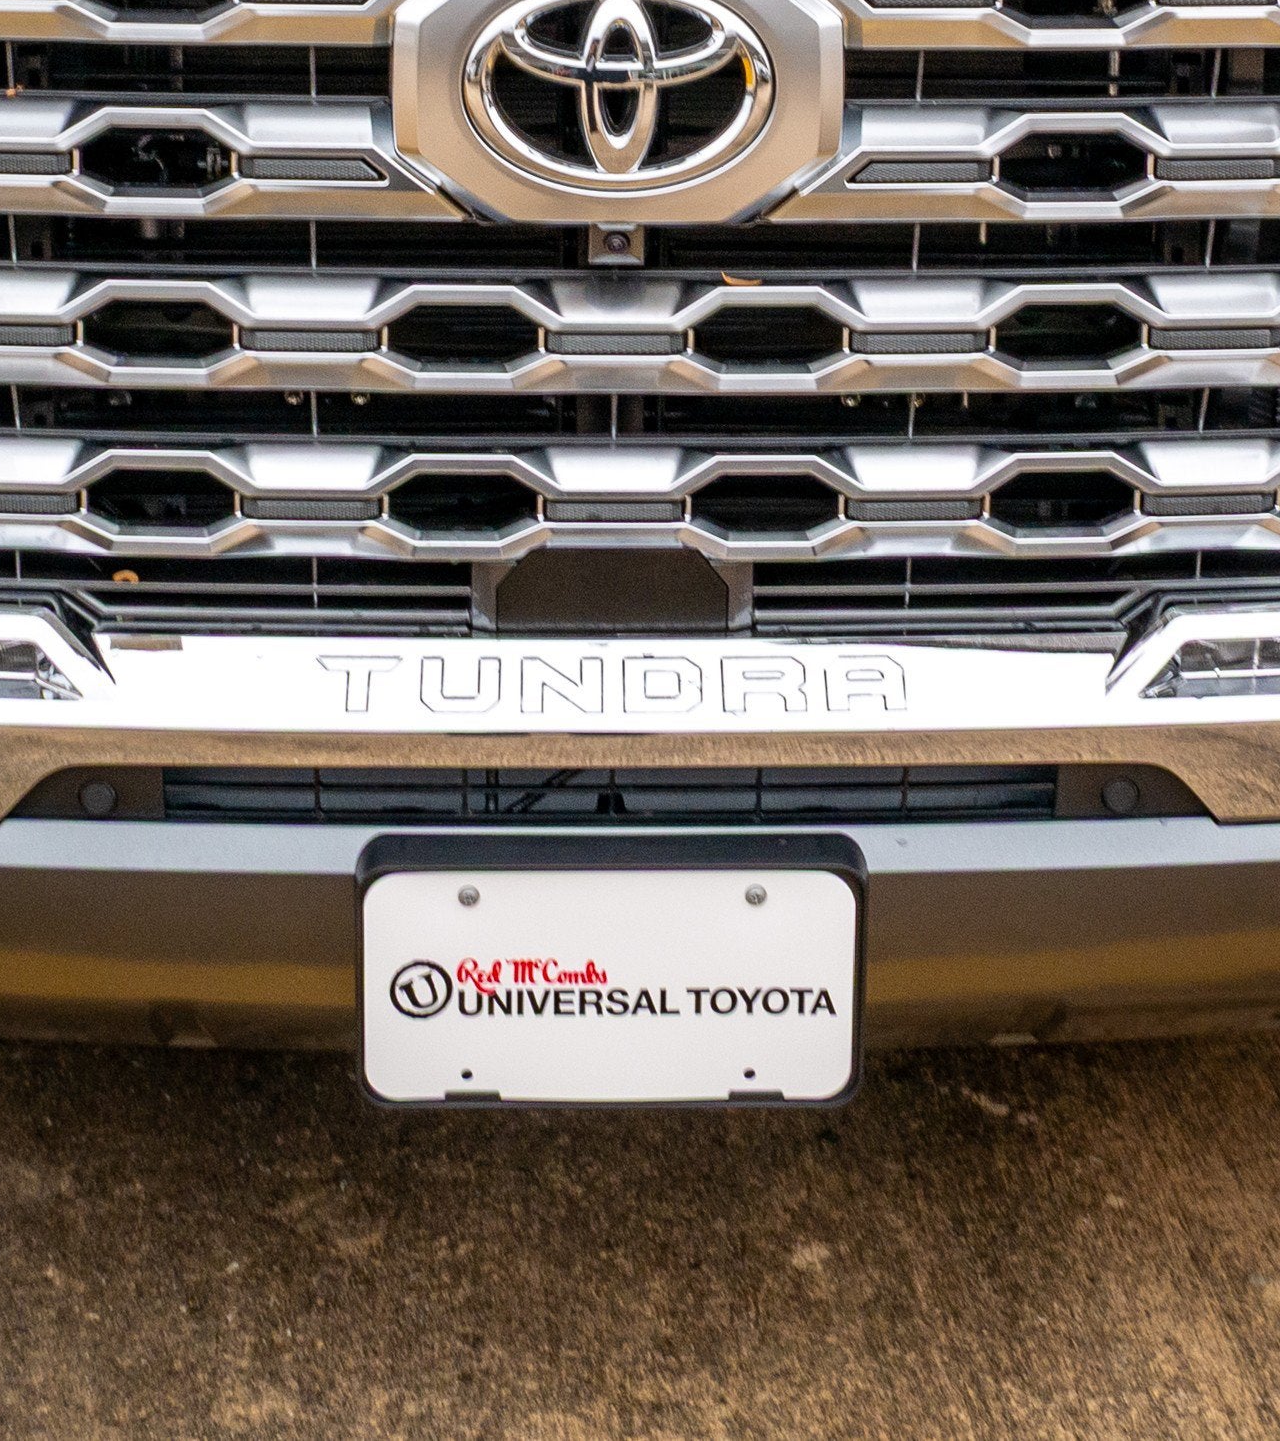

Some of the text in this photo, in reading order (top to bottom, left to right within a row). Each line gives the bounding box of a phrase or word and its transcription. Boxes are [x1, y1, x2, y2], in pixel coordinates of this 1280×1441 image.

[317, 654, 909, 715] TUNDRA
[456, 957, 502, 995] Red
[457, 987, 837, 1017] UNIVERSAL TOYOTA
